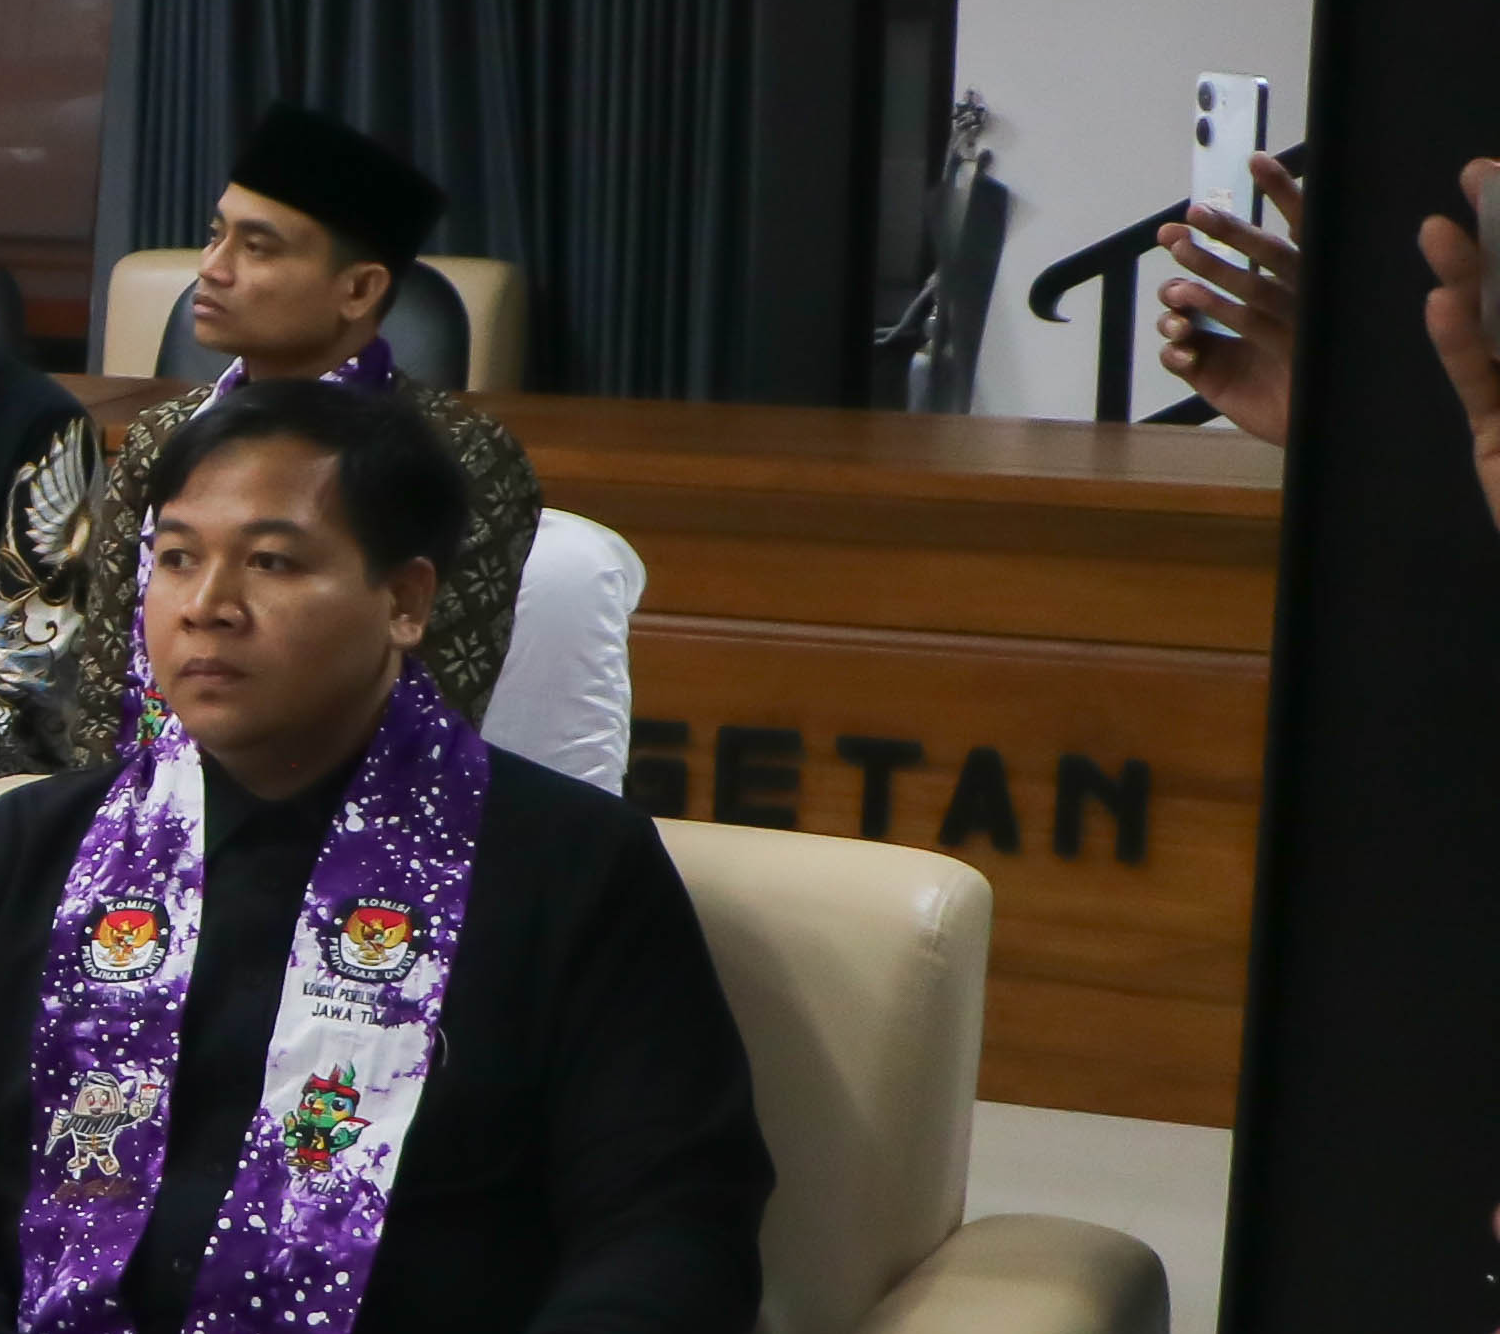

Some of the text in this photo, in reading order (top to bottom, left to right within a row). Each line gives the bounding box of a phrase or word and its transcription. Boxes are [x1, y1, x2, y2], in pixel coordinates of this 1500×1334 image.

[106, 900, 156, 914] KOMISI
[358, 898, 411, 914] KOMISI
[311, 1002, 352, 1022] JAWA
